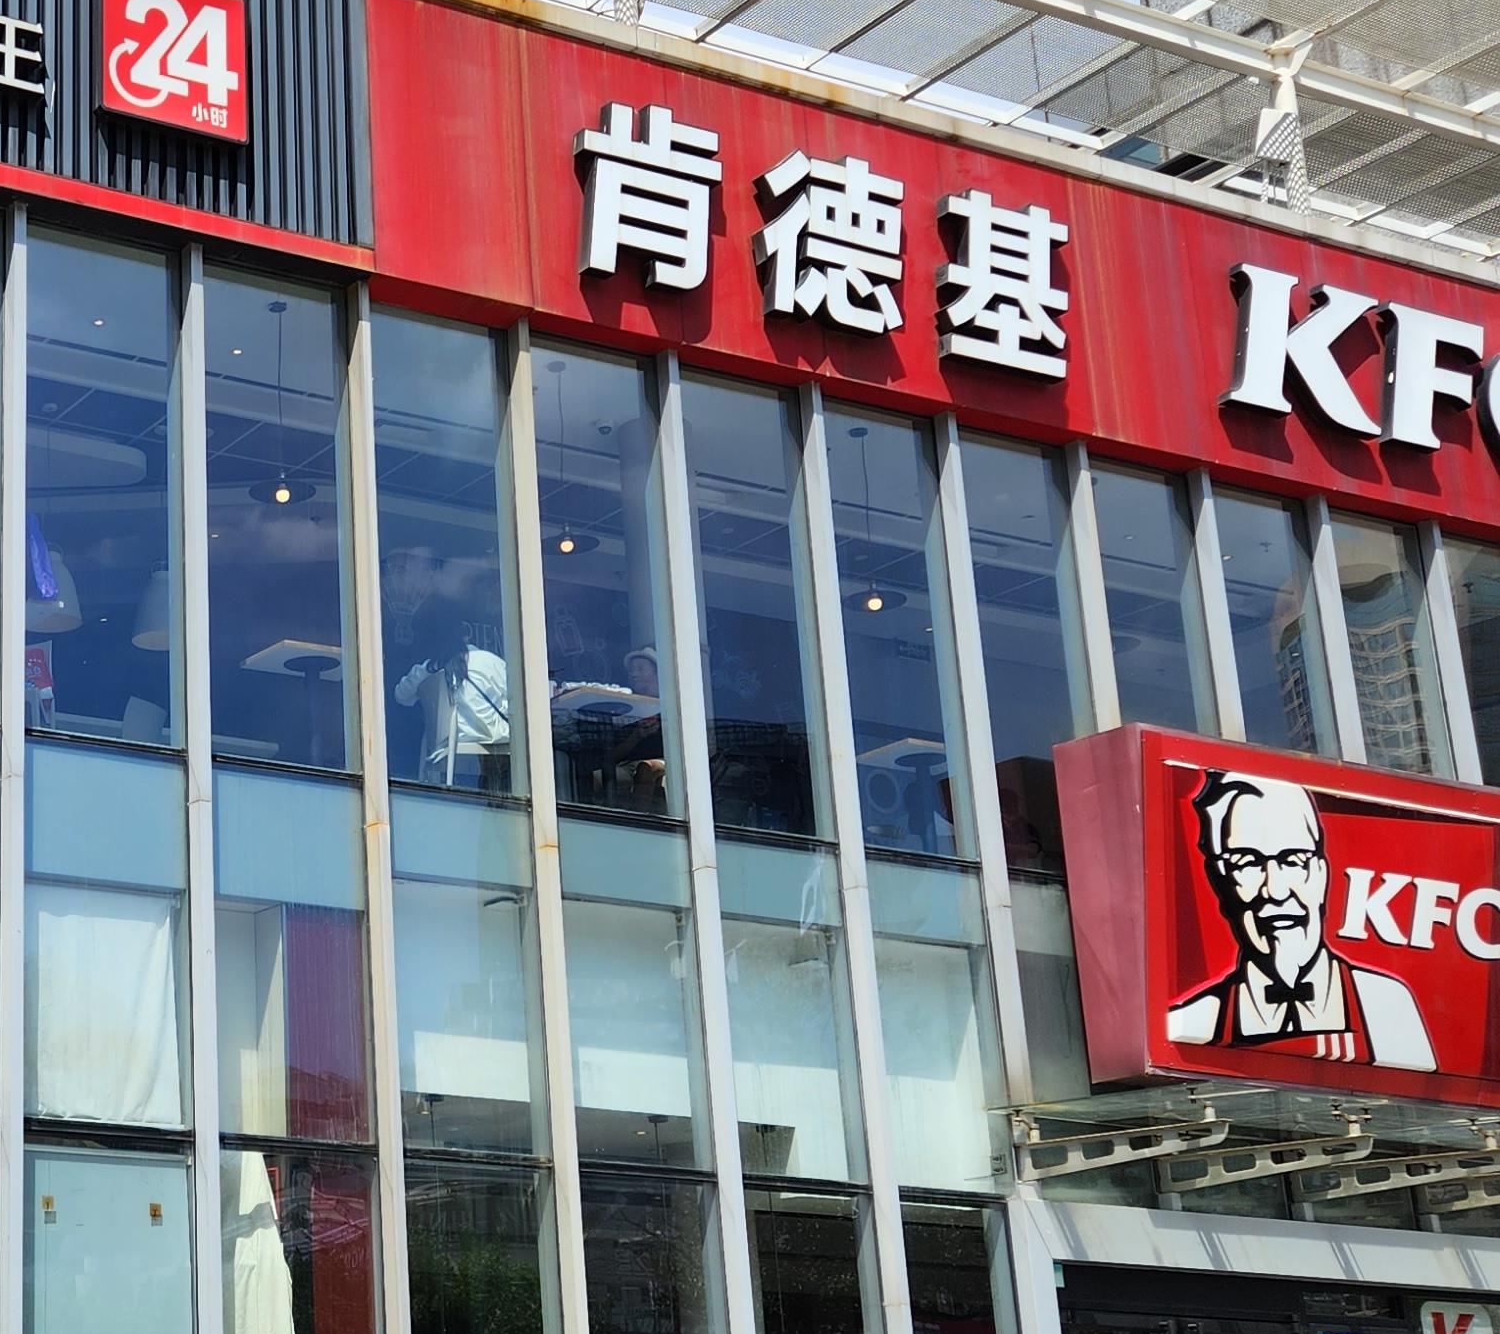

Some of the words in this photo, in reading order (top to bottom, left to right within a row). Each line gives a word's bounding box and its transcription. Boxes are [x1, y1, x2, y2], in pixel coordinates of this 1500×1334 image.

[192, 102, 228, 129] 小时
[573, 101, 1070, 380] 肯德基
[1220, 263, 1500, 469] KF
[1337, 867, 1500, 961] KFC
